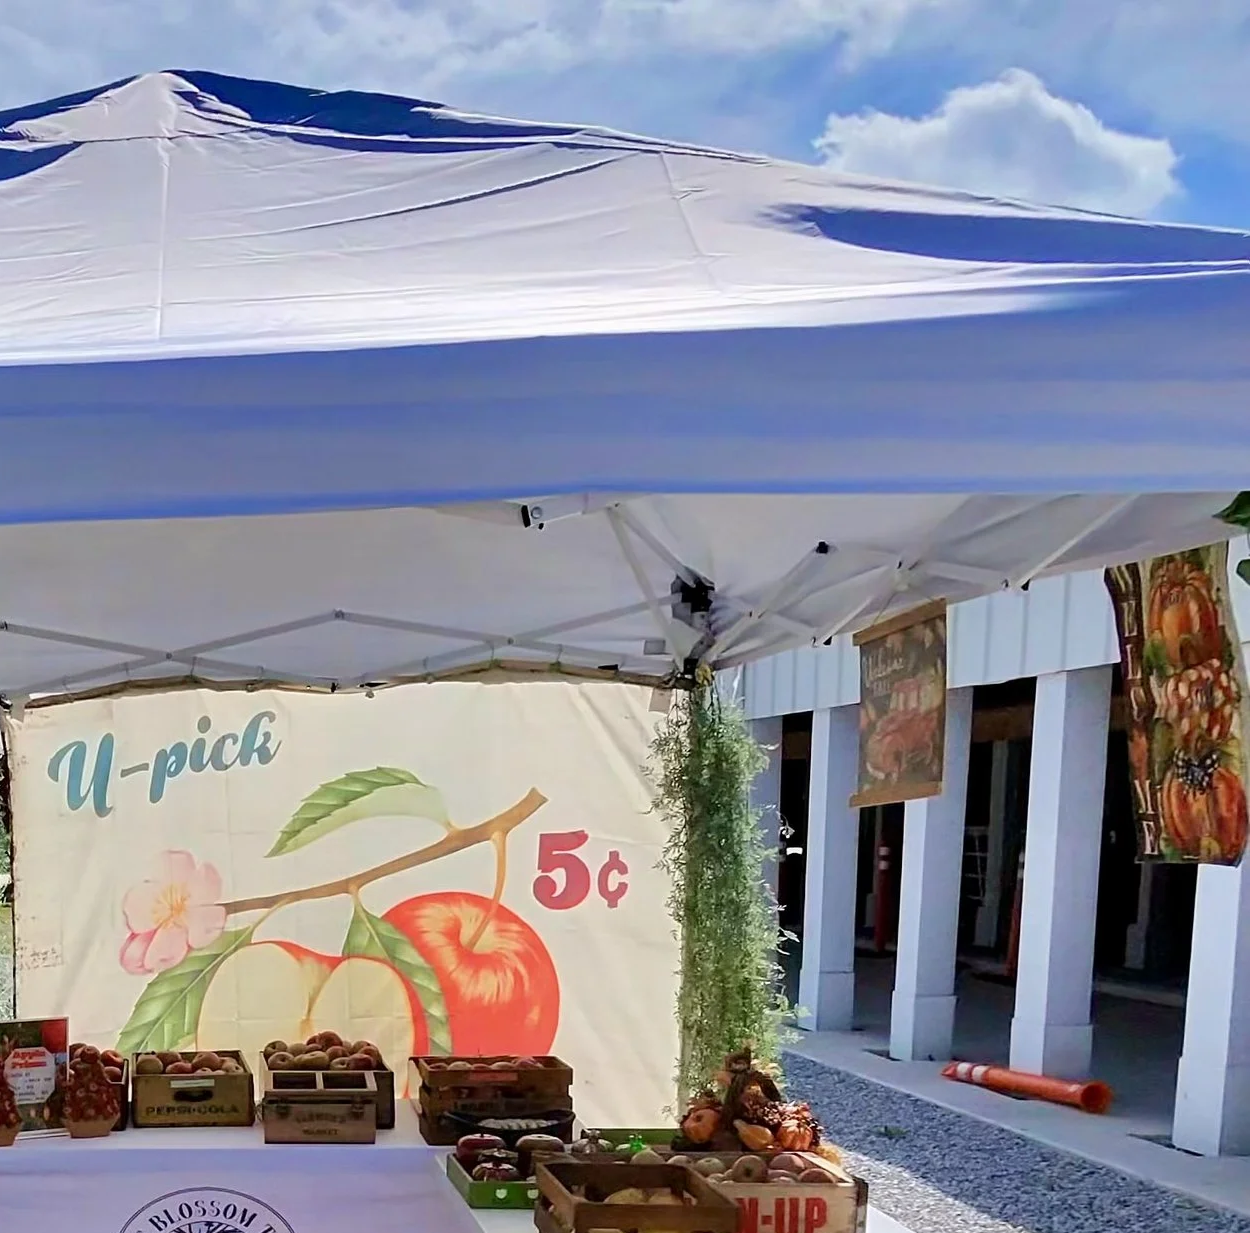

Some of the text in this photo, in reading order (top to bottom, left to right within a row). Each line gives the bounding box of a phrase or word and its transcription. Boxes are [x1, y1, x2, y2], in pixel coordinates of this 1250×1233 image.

[47, 710, 283, 818] U-pick
[532, 830, 630, 910] 5¢
[148, 1200, 258, 1232] BLOSSOM
